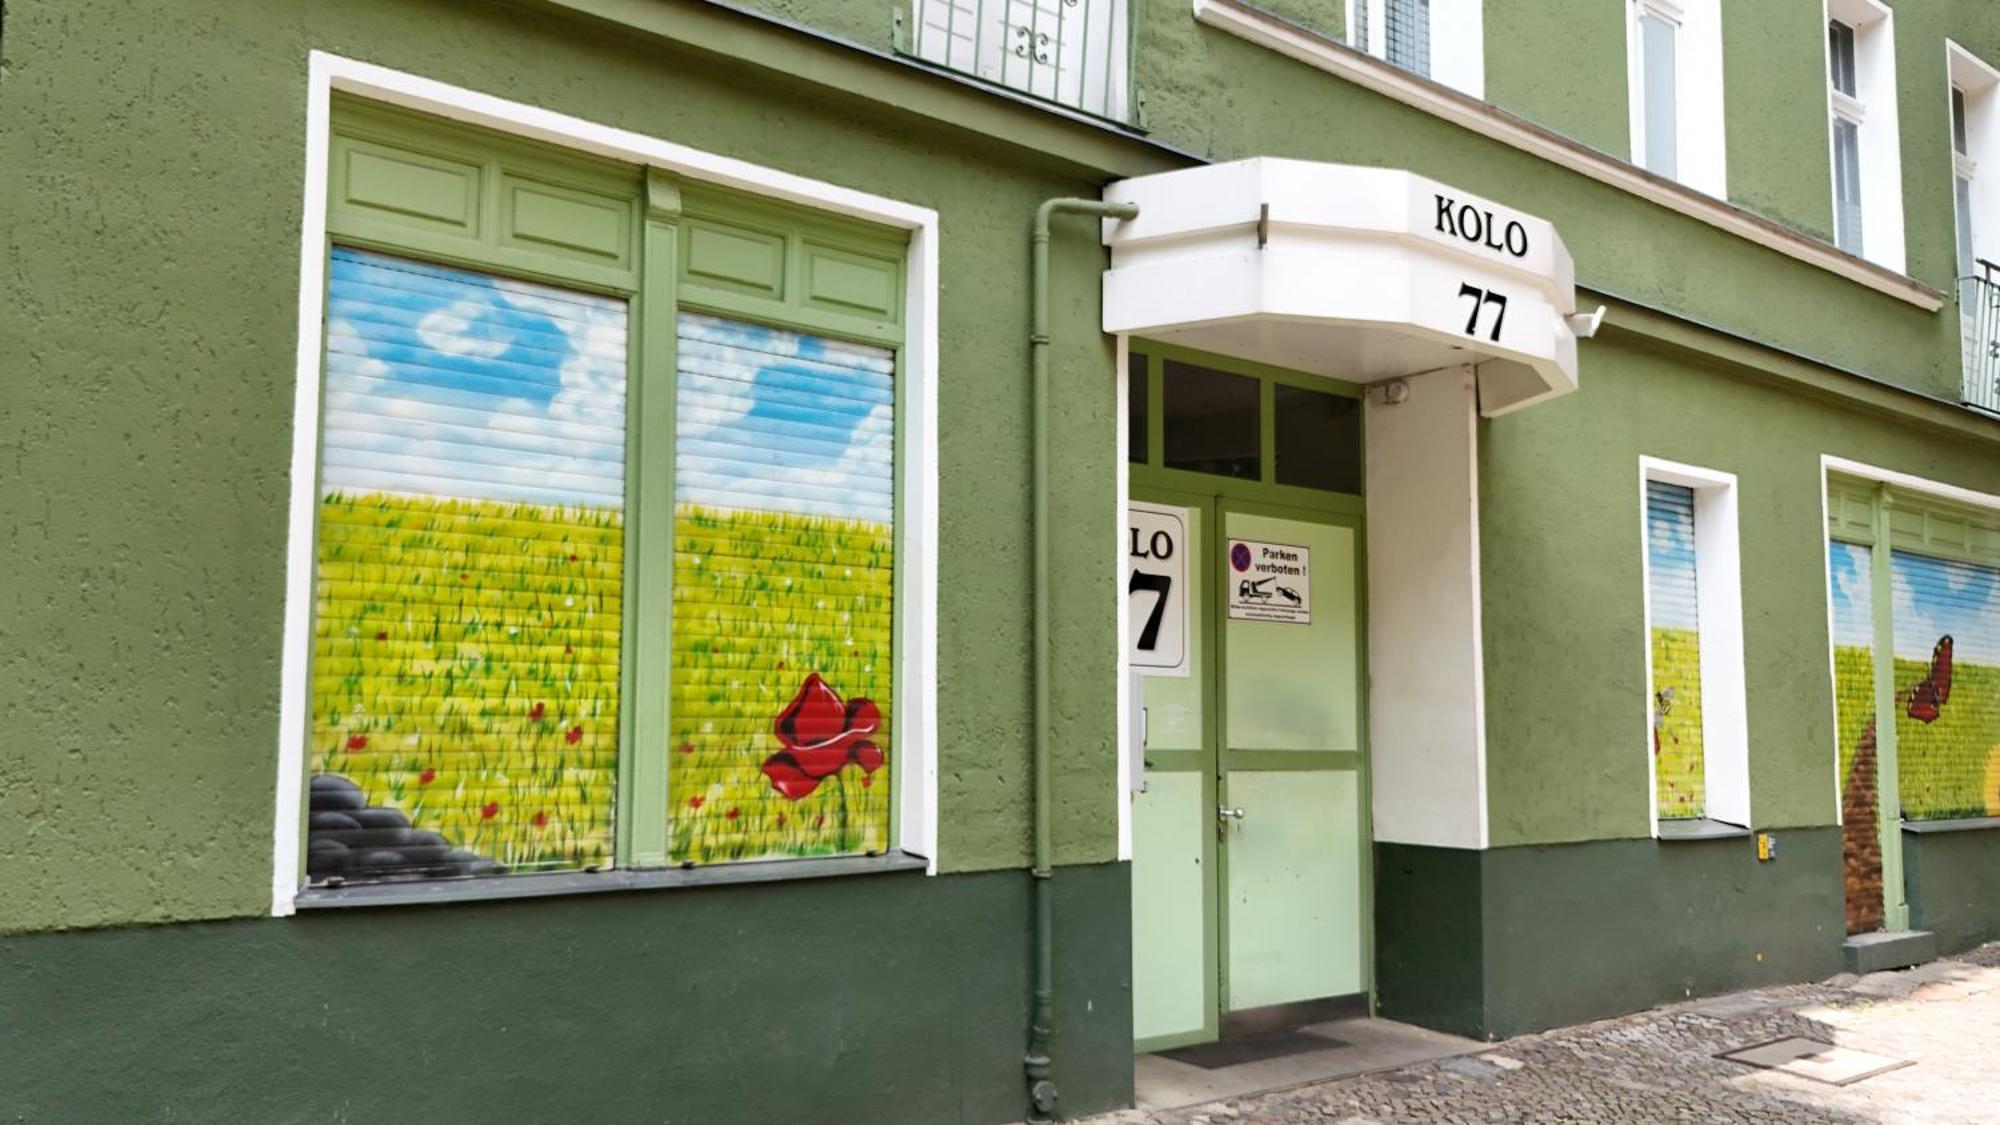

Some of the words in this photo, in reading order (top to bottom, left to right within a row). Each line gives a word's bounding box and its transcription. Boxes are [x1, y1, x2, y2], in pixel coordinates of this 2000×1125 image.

[1434, 194, 1528, 258] KOLO
[1458, 282, 1507, 342] 77
[1130, 527, 1173, 560] LO
[1262, 547, 1298, 561] Parken
[1128, 568, 1172, 651] 7
